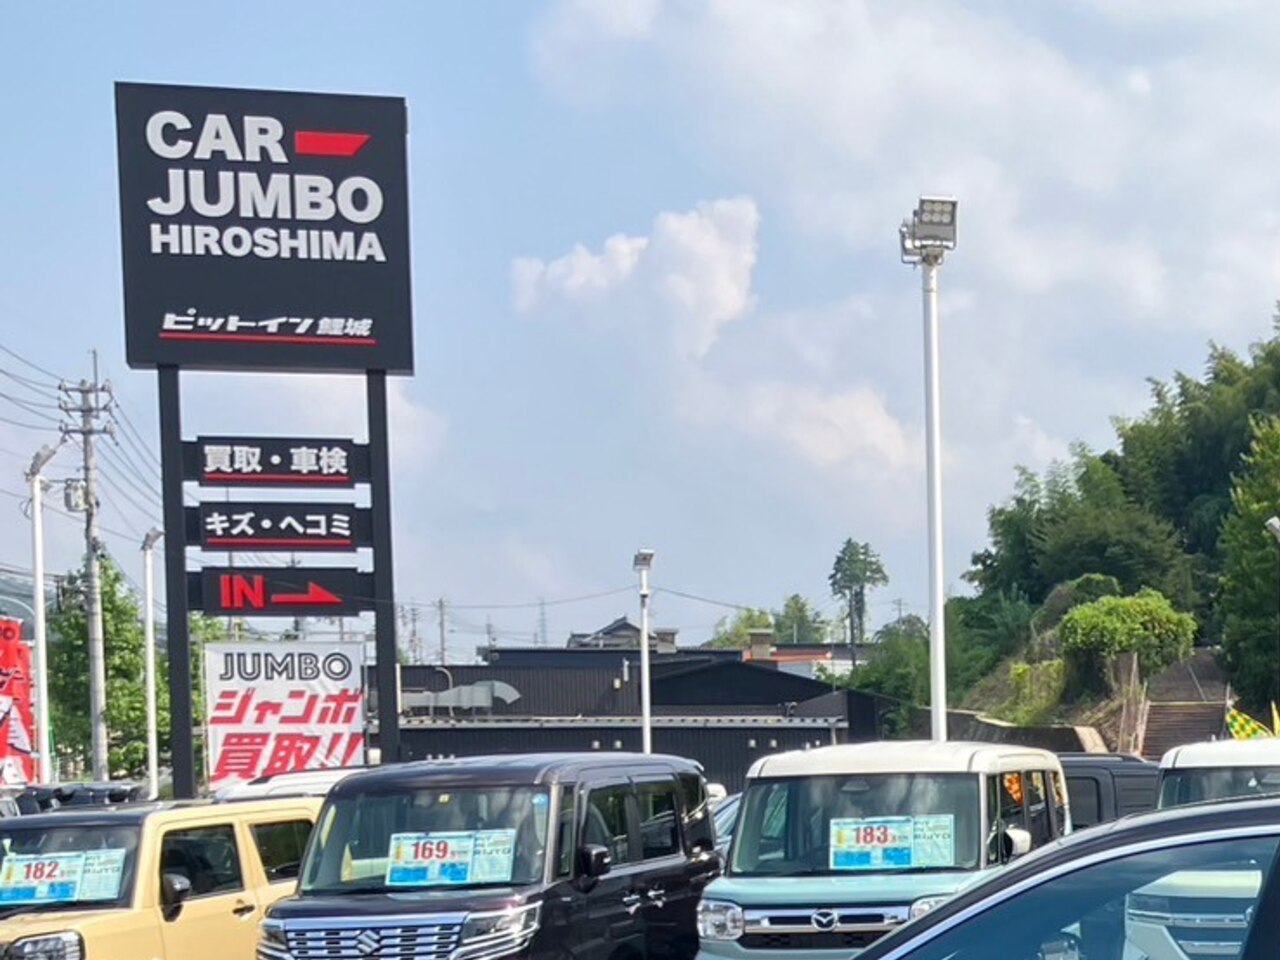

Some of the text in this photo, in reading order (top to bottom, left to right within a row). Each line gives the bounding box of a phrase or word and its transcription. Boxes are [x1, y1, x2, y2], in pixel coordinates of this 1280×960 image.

[146, 110, 289, 163] CAR
[146, 168, 383, 223] JUMBO
[150, 223, 386, 262] HIROSHIMA
[220, 574, 264, 608] IN
[219, 652, 352, 681] JUMBO
[210, 687, 364, 725] ジャンボ
[411, 840, 449, 860] 169
[853, 825, 889, 844] 183
[24, 860, 60, 880] 182
